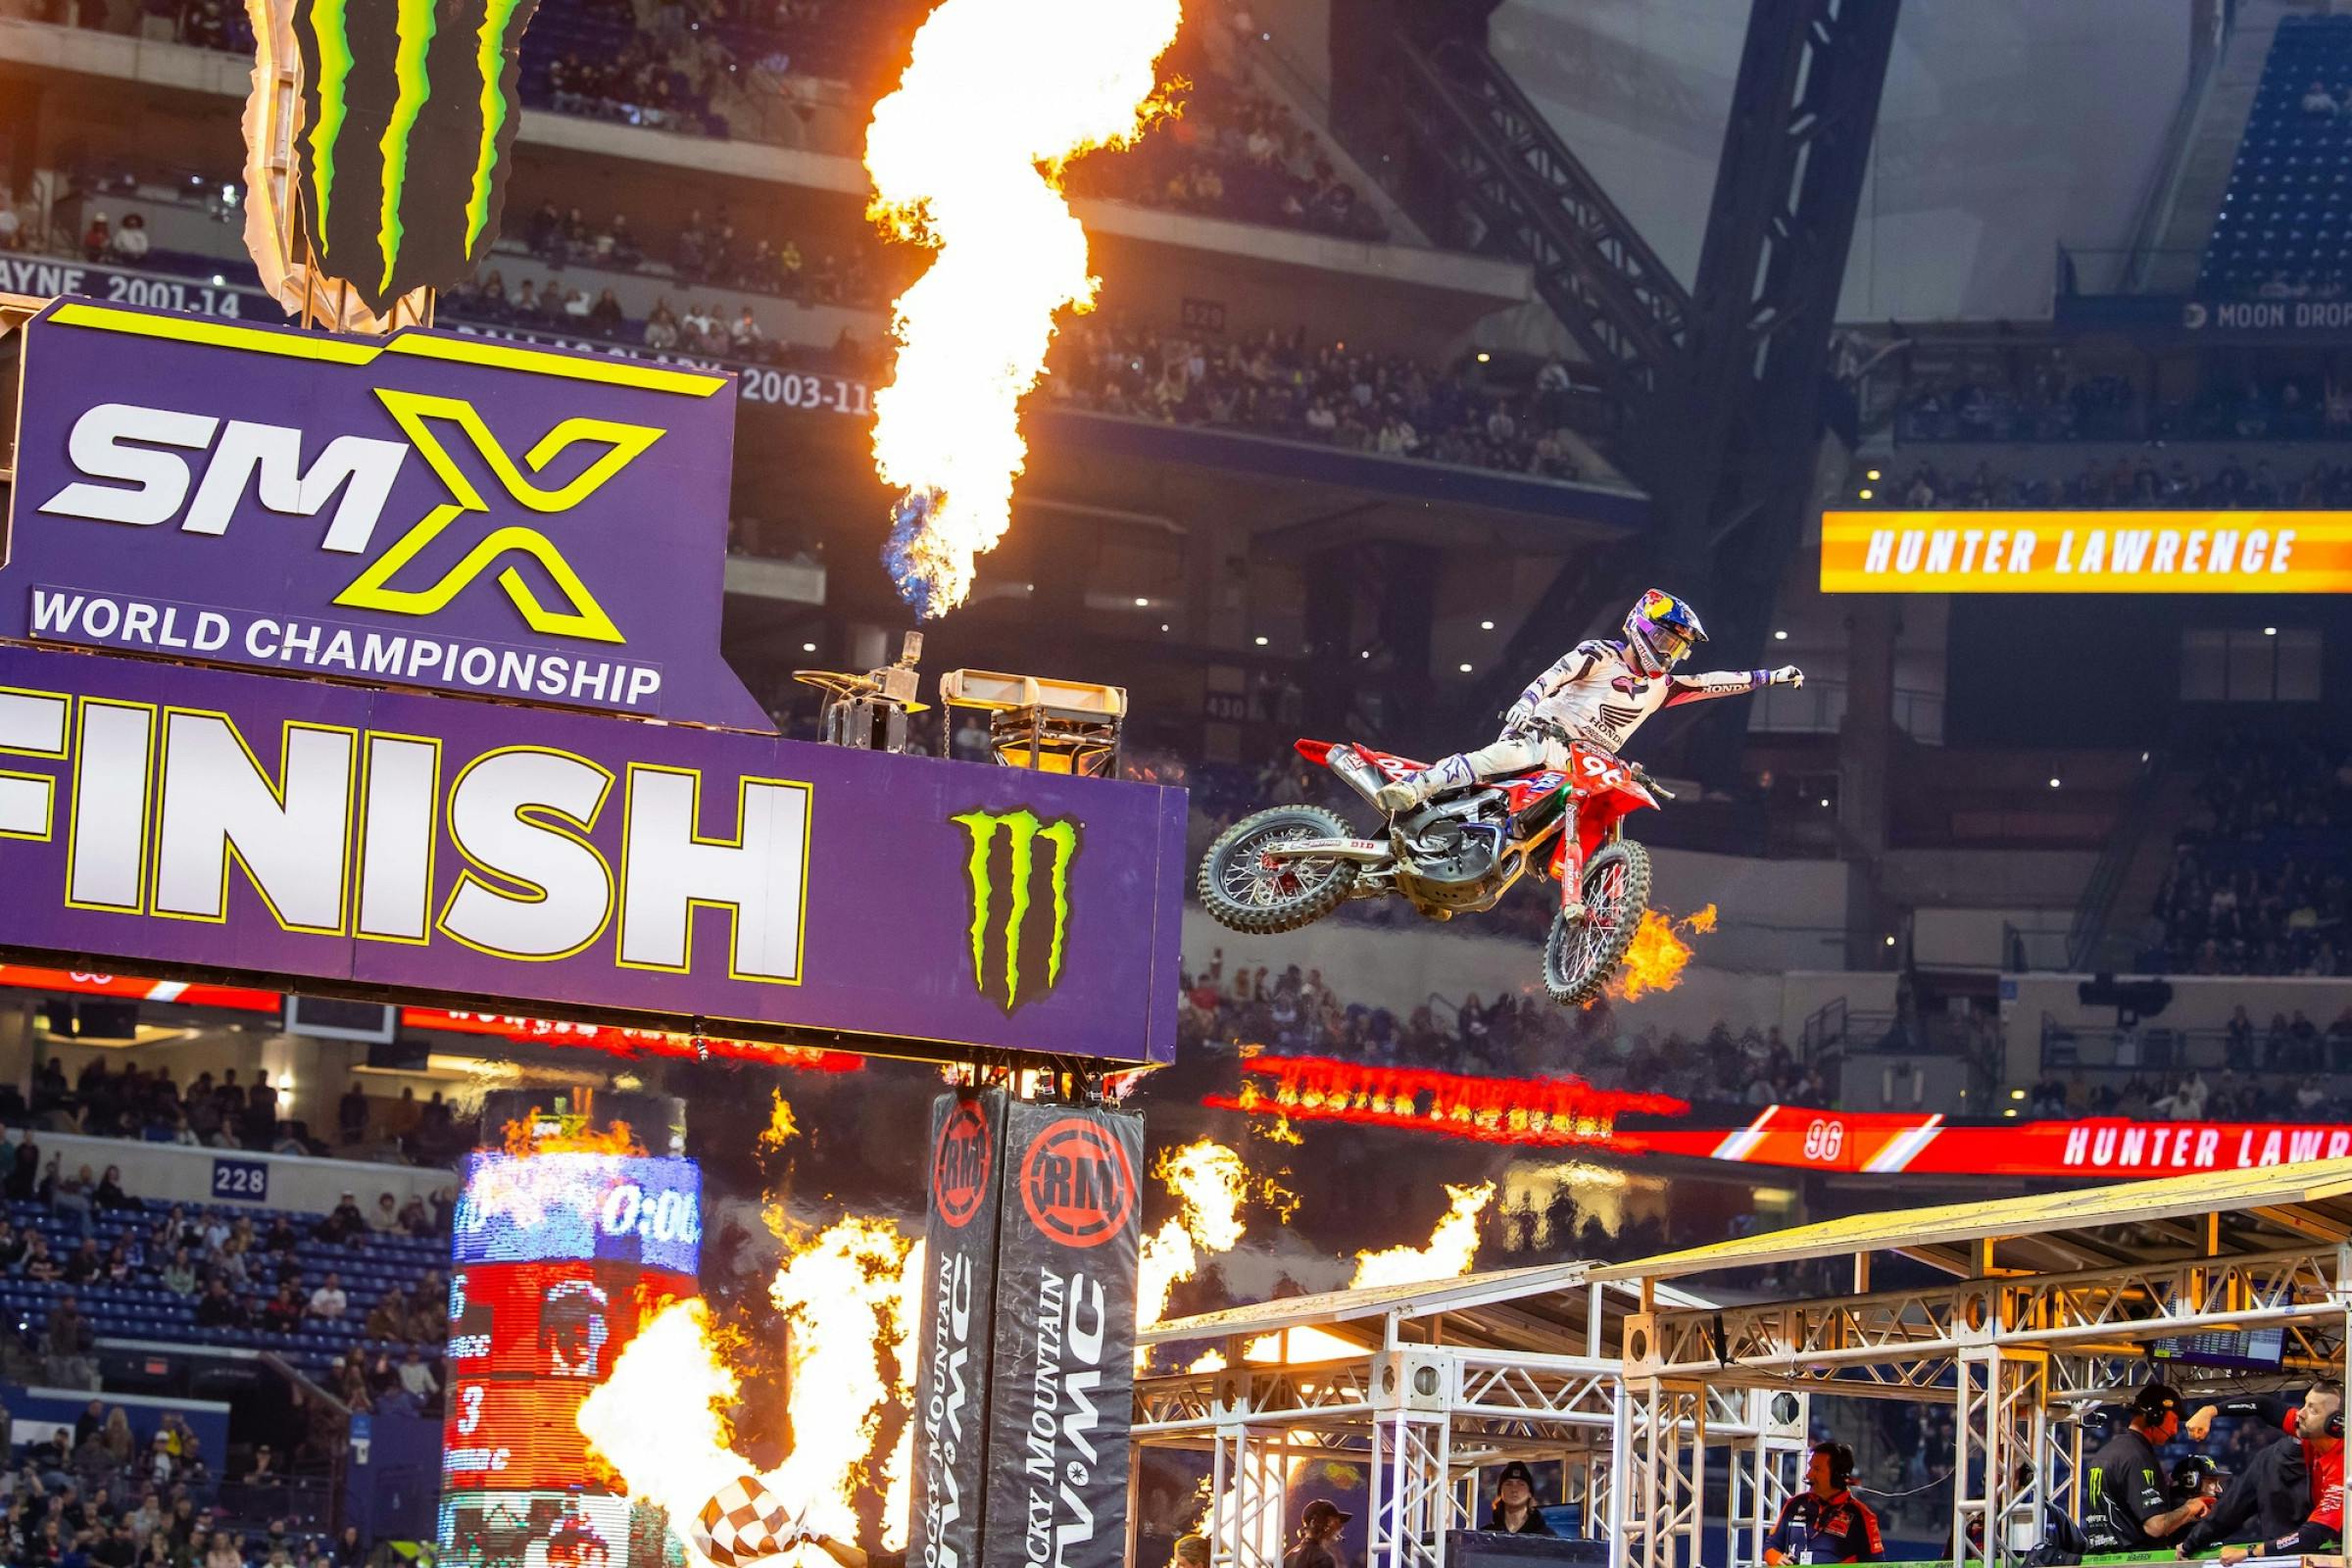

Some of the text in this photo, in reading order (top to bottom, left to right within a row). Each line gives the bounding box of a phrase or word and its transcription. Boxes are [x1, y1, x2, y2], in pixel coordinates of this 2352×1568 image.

[108, 275, 240, 319] 2001-14
[2218, 303, 2284, 327] MOON
[742, 368, 869, 416] 2003-11
[38, 387, 666, 644] SMX
[1864, 530, 2296, 574] HUNTER LAWRENCE
[32, 590, 662, 706] WORLD CHAMPIONSHIP
[1702, 684, 1751, 694] HONDA
[1582, 756, 1624, 785] 96
[1803, 1118, 1842, 1162] 96
[2063, 1126, 2219, 1167] HUNTER
[217, 1166, 265, 1194] 228
[925, 1251, 954, 1468] MOUNTAIN
[1024, 1266, 1065, 1568] CKY MOUNTAIN
